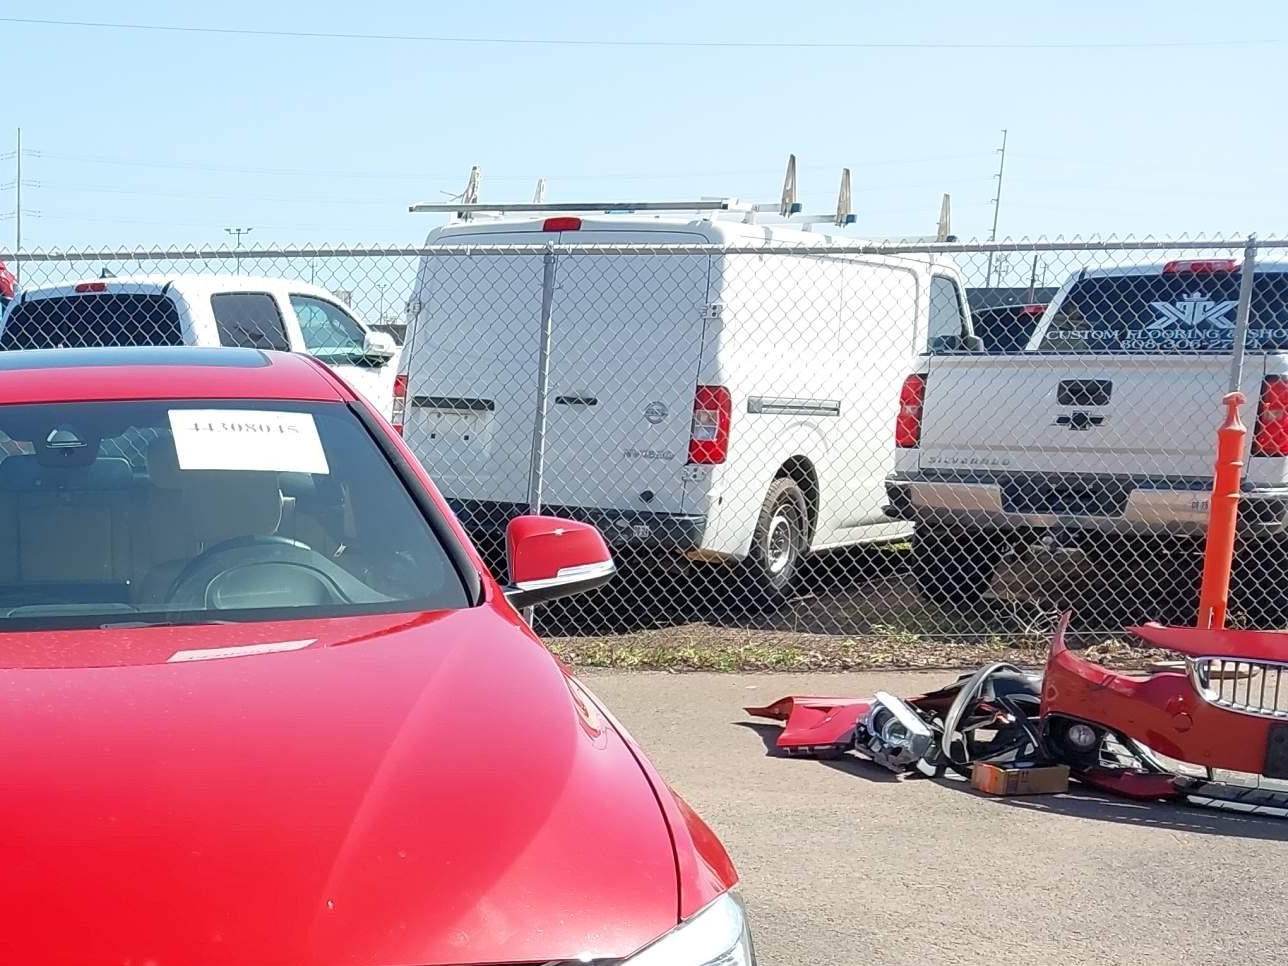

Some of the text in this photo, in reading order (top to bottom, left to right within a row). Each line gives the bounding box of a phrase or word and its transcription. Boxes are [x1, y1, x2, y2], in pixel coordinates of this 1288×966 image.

[1047, 330, 1119, 340] CUSTOM
[1126, 330, 1219, 340] FLOORING
[1247, 329, 1288, 341] SHO
